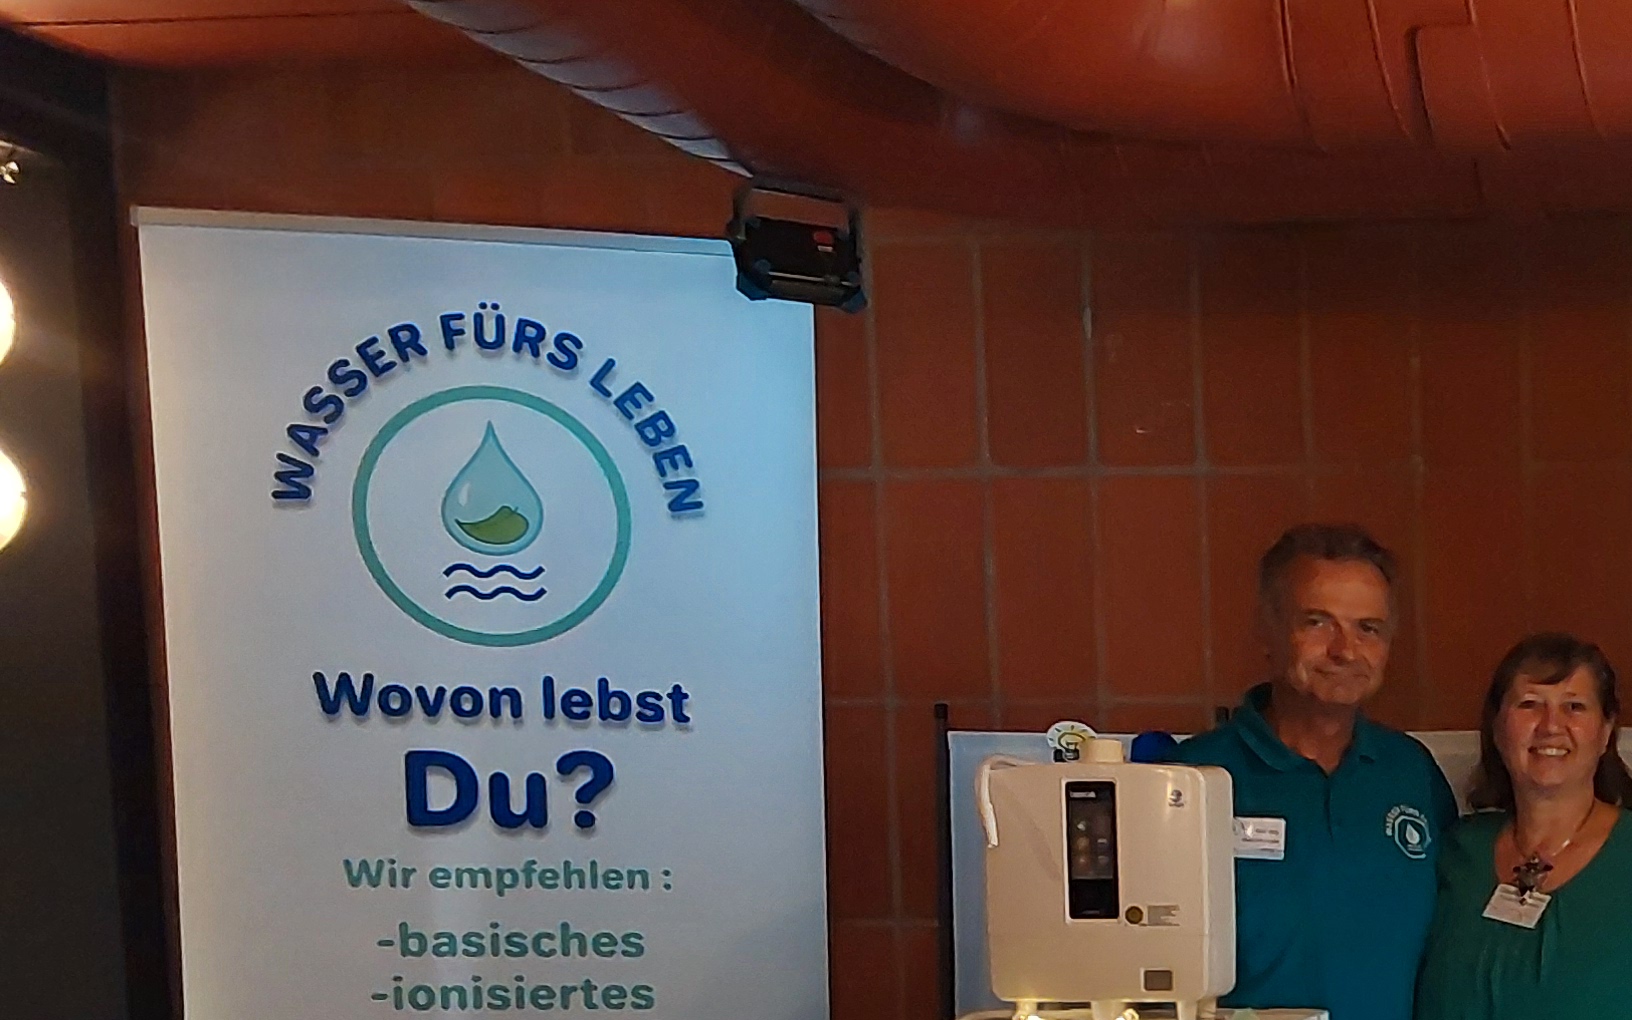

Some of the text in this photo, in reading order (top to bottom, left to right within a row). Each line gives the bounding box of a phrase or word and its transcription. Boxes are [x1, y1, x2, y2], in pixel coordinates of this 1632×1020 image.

[272, 302, 704, 517] WASSER FÜRS LEBEN
[312, 672, 691, 724] Wovon lebst
[404, 750, 615, 829] Du?
[343, 859, 416, 889] Wir
[429, 860, 650, 897] empfehlen
[377, 922, 646, 958] -basisches
[370, 975, 655, 1012] -ionisiertes
